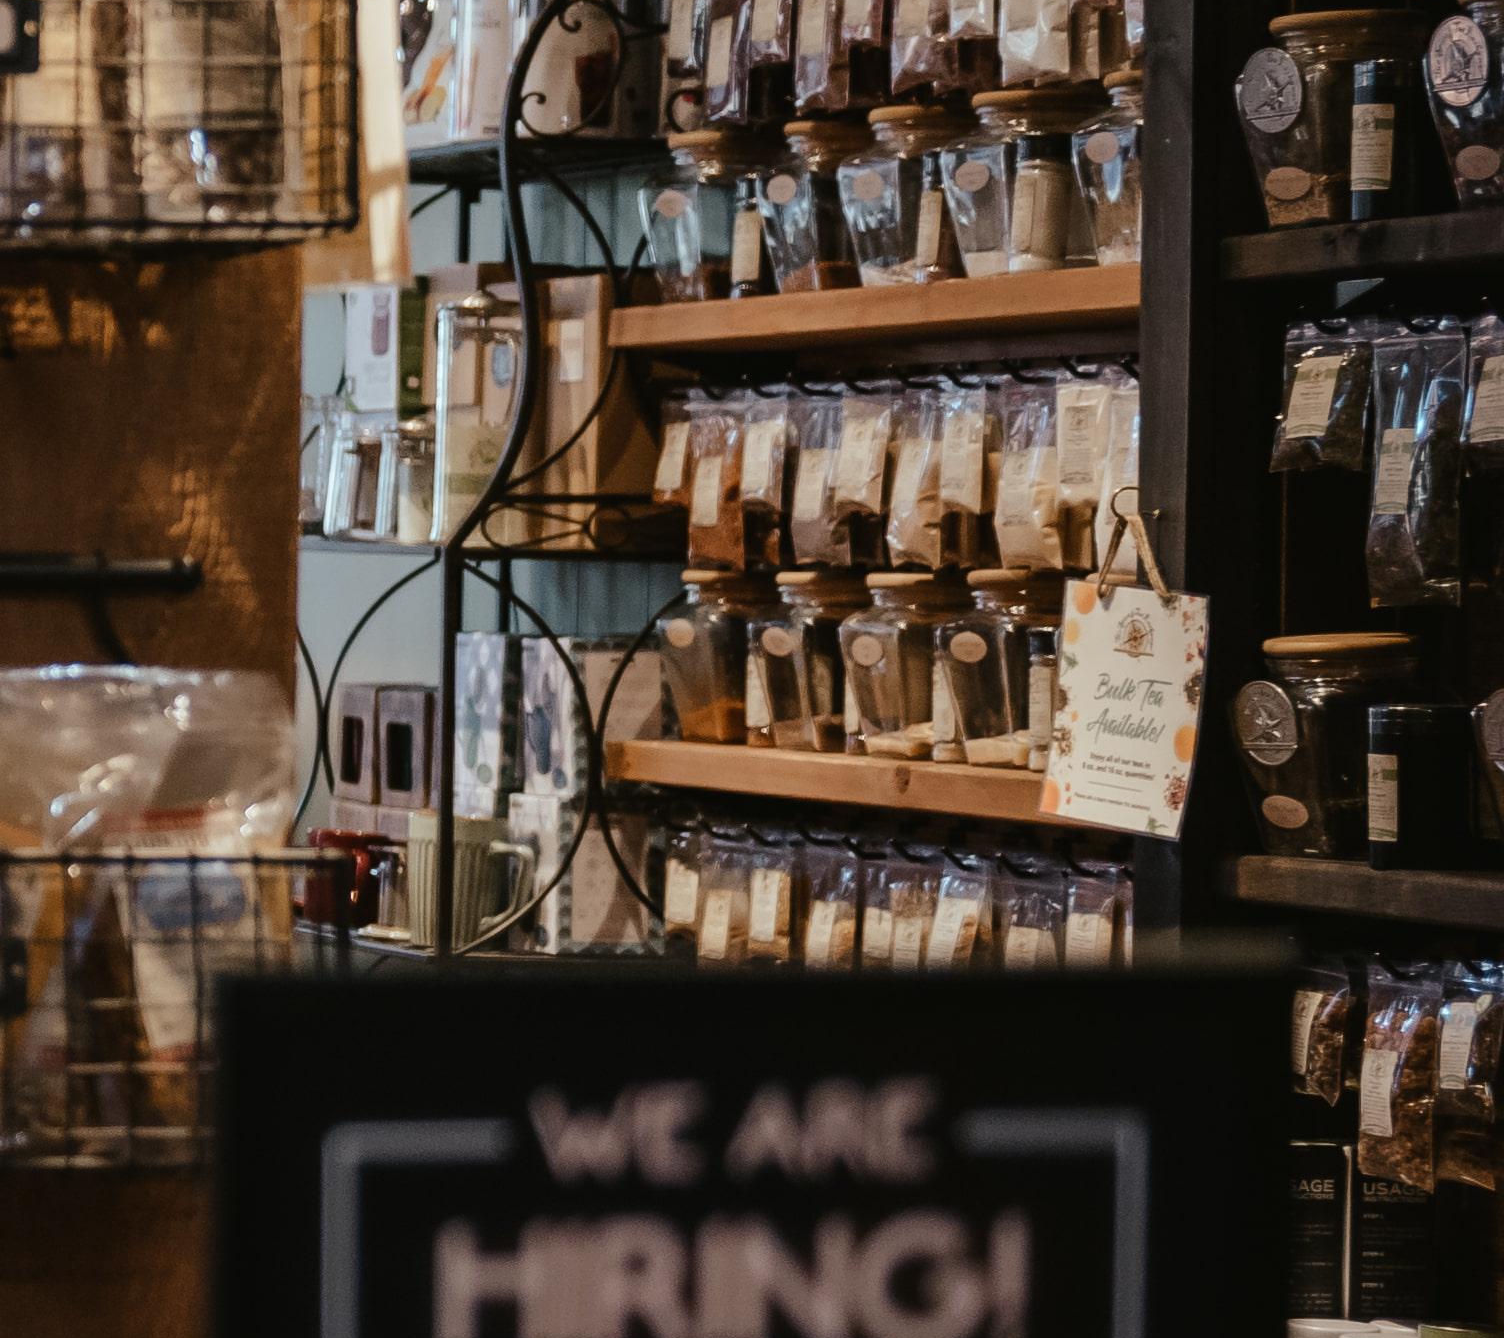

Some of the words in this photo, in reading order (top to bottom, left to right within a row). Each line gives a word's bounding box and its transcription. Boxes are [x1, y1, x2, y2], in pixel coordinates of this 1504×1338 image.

[1093, 672, 1137, 702] Bulk
[1137, 678, 1173, 712] Tea
[533, 1079, 713, 1183] WE
[728, 1075, 937, 1181] ARE
